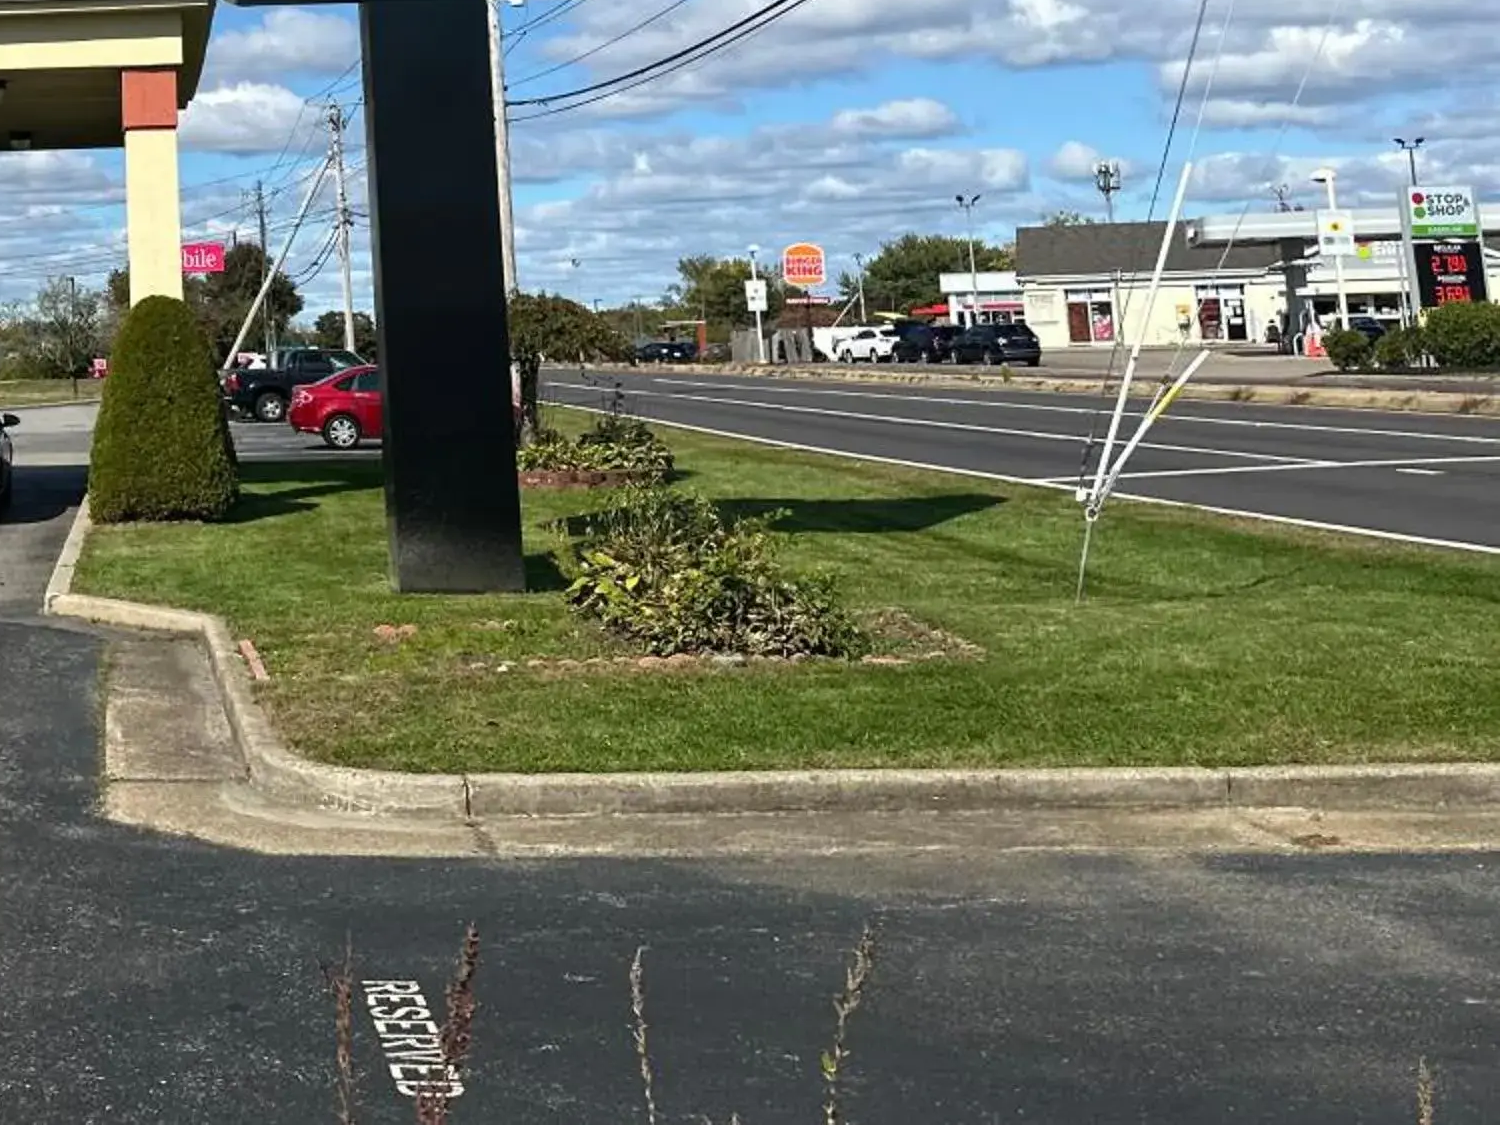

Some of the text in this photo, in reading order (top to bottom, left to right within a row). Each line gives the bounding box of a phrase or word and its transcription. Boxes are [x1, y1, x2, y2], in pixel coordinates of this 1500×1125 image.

[1425, 193, 1463, 204] STOP
[1427, 204, 1465, 216] SHOP
[183, 246, 218, 268] bile
[786, 266, 823, 276] KING
[361, 980, 466, 1098] RESERVED
